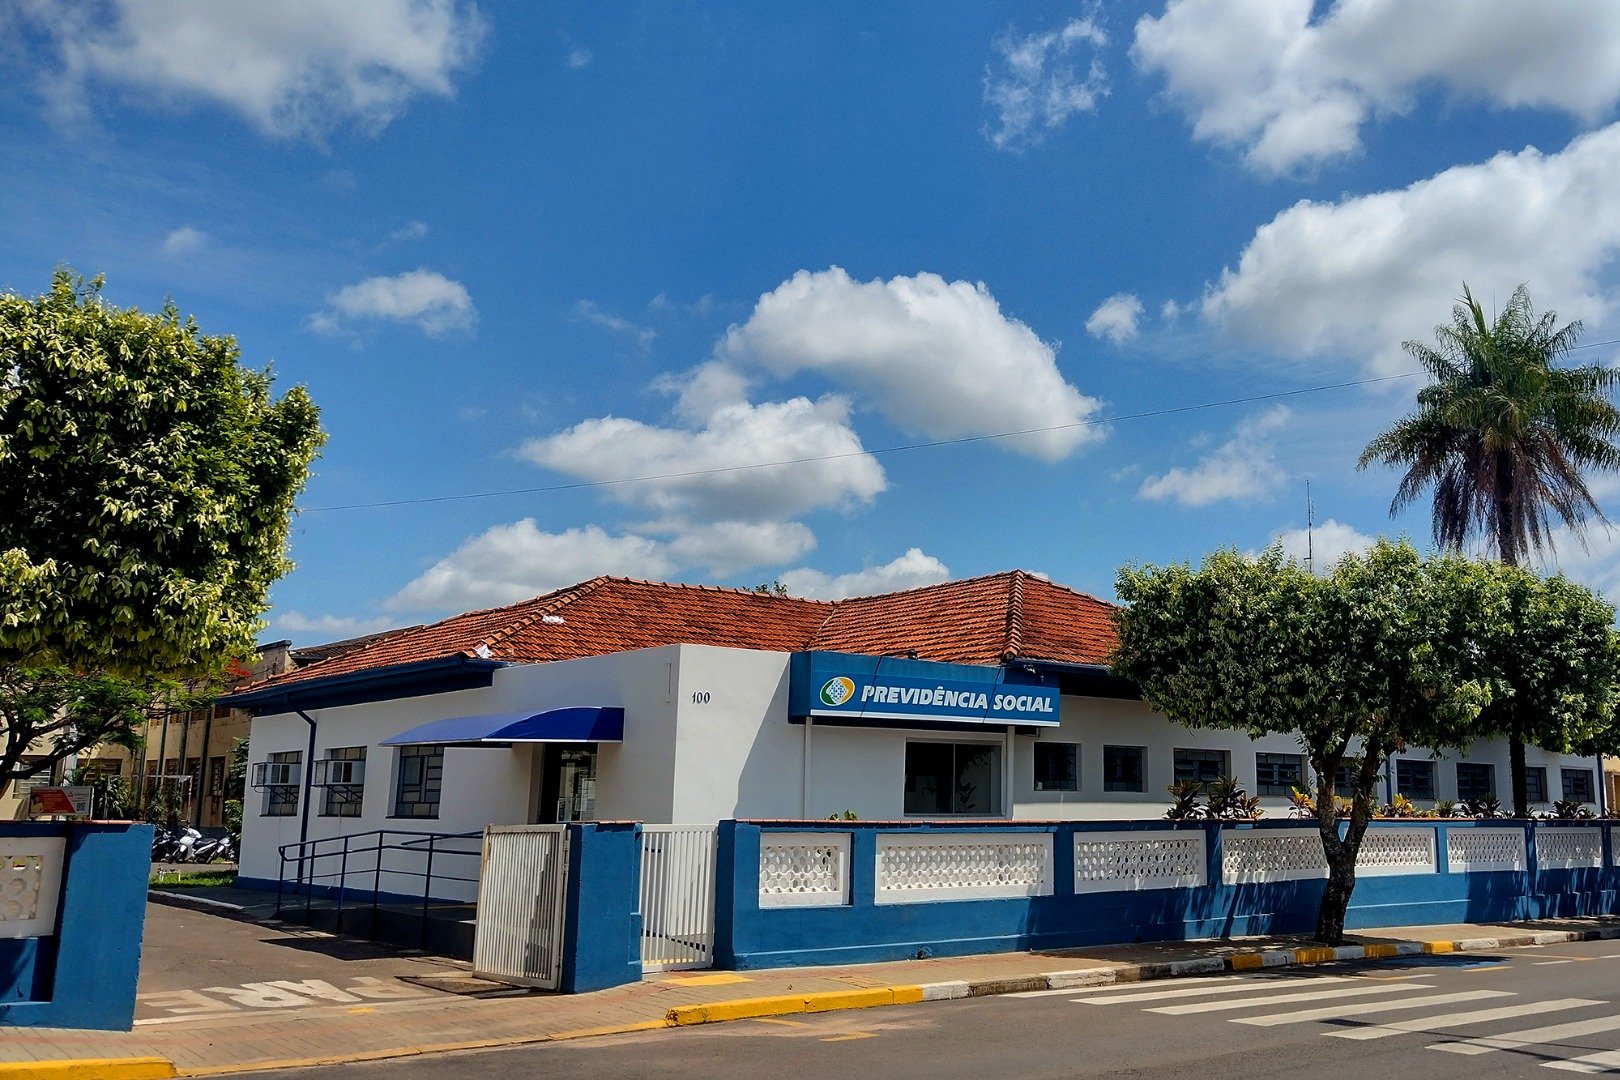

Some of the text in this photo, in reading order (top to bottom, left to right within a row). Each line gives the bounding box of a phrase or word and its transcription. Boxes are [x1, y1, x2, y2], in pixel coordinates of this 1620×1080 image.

[692, 691, 711, 704] 100
[861, 685, 1054, 713] PREVIDÊNCIA SOCIAL
